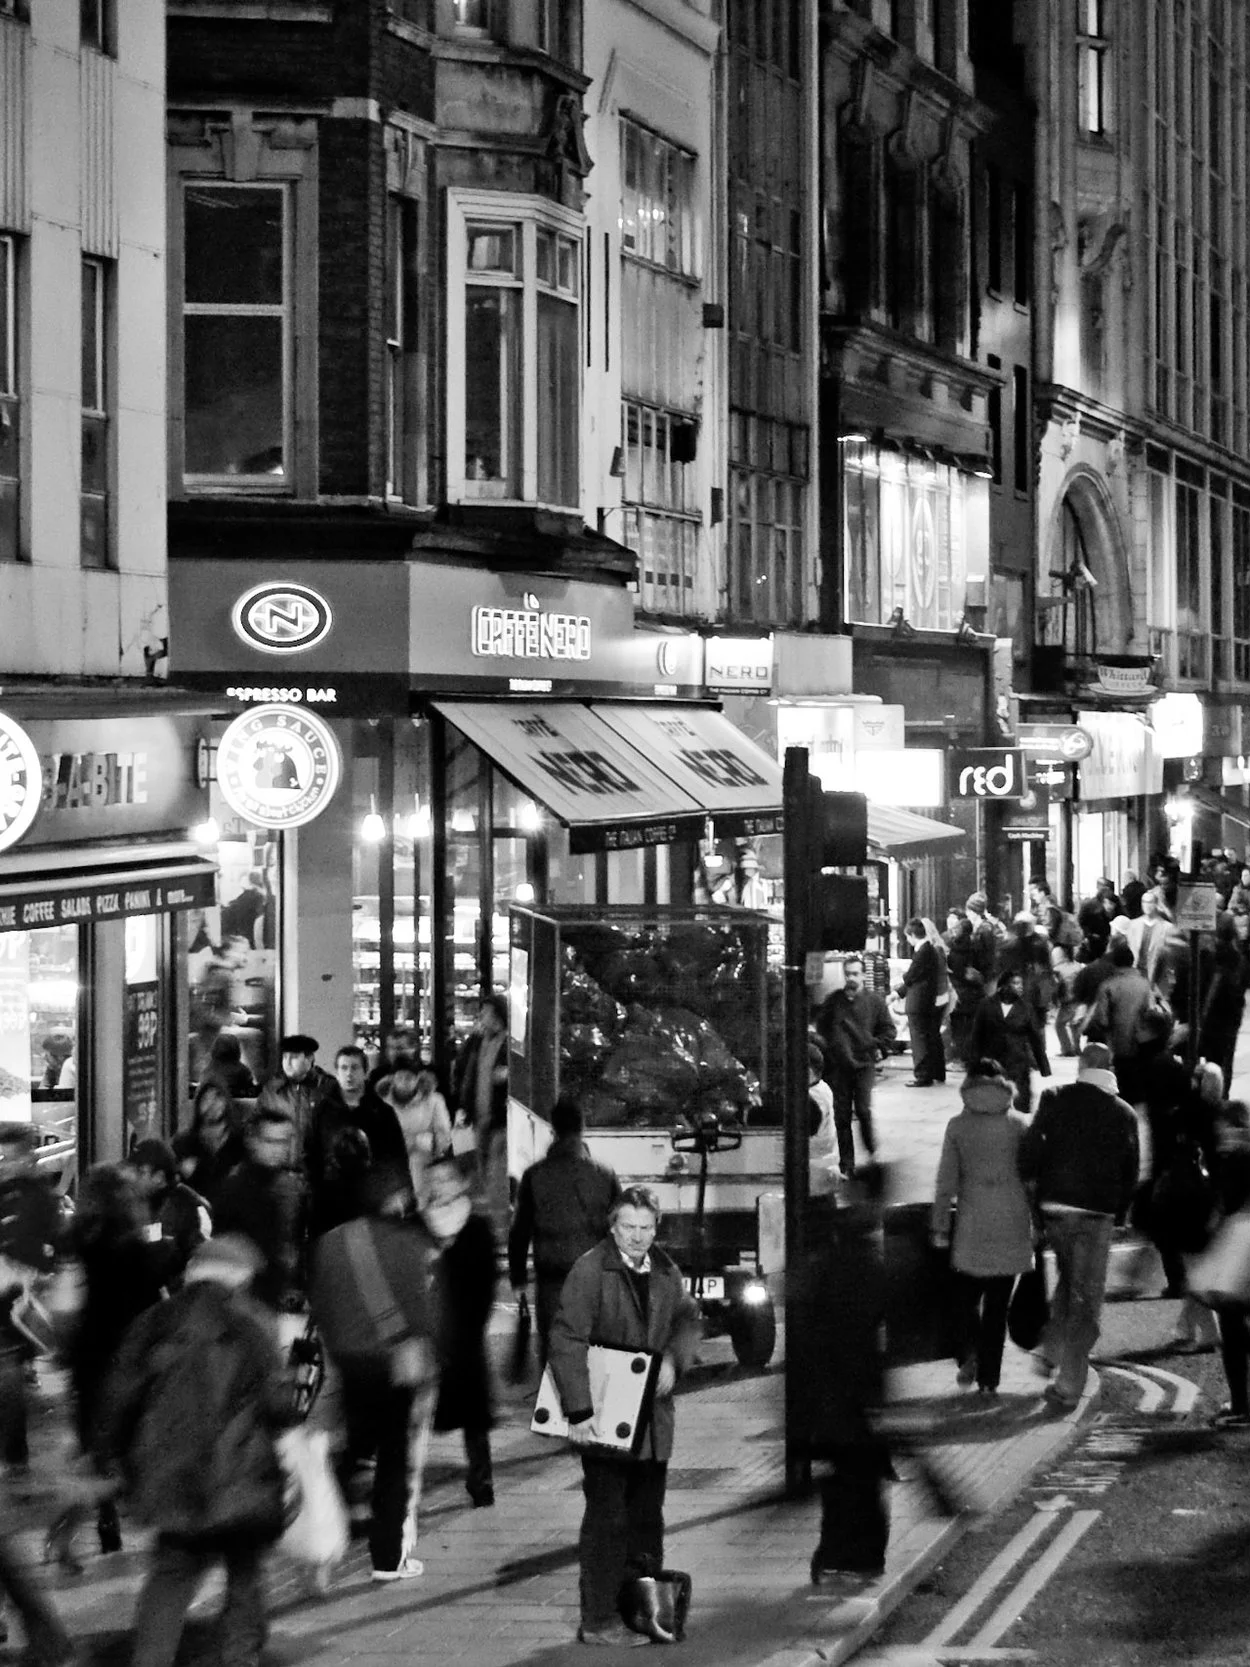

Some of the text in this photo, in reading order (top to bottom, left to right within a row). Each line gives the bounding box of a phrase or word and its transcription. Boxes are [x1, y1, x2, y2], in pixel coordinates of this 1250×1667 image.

[540, 612, 591, 660] NERO
[710, 665, 768, 681] NERO
[306, 688, 337, 702] BAR
[276, 715, 328, 774] SAUCE
[524, 749, 643, 795] NERO
[672, 749, 771, 788] NERO
[959, 754, 1014, 796] red
[23, 901, 55, 923] COFFEE
[60, 896, 92, 918] SALADS
[97, 893, 120, 914] PIZZA
